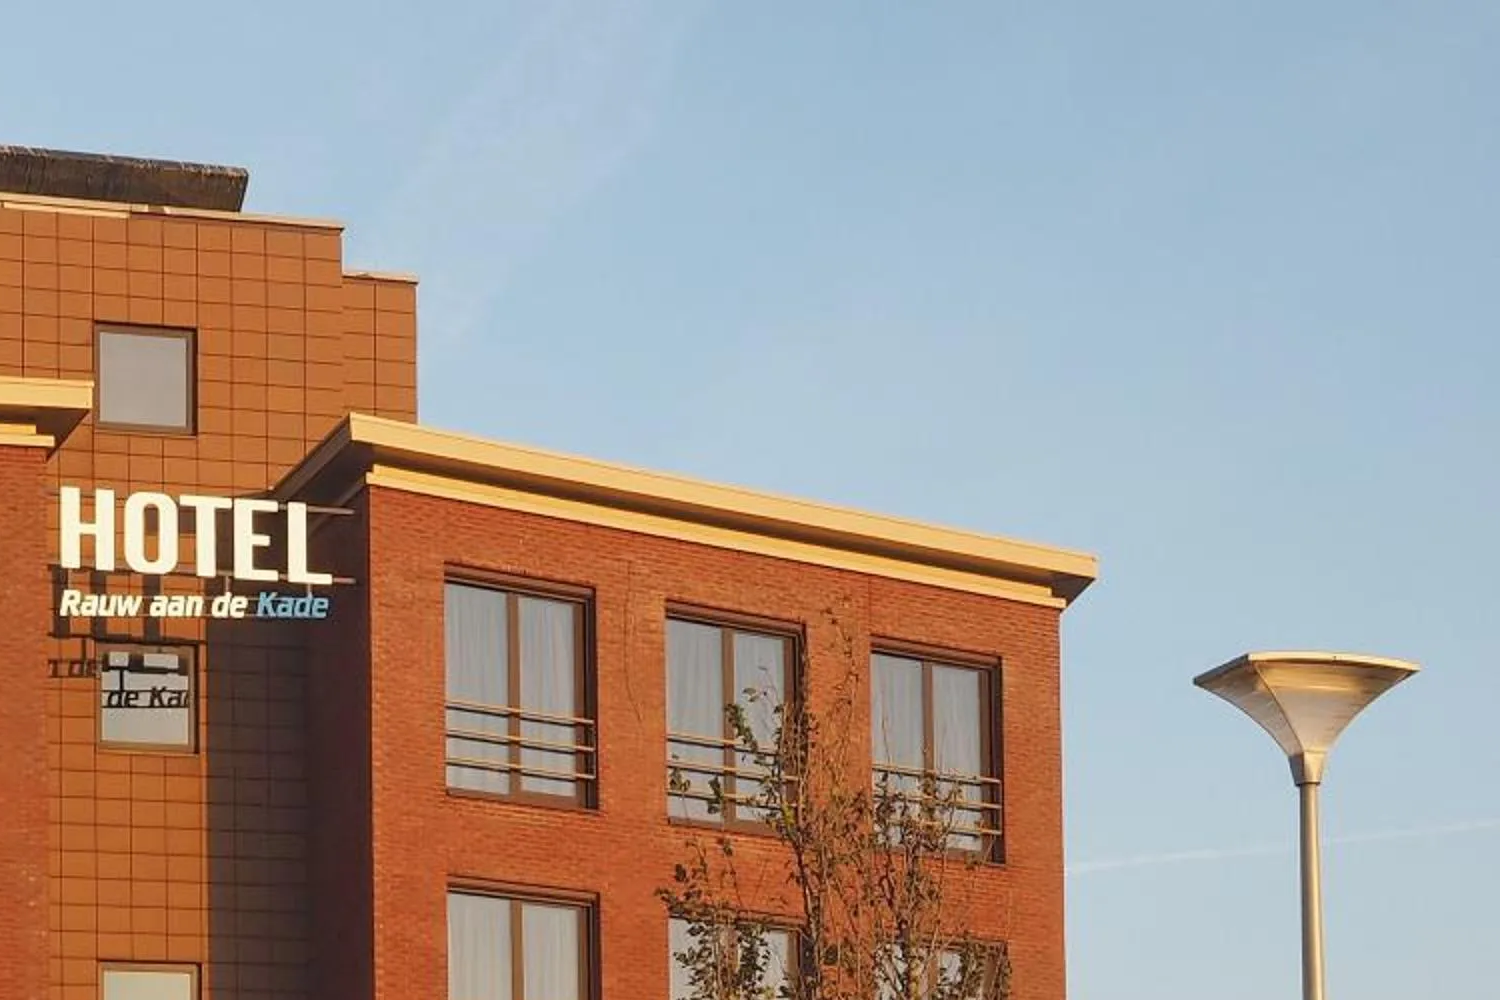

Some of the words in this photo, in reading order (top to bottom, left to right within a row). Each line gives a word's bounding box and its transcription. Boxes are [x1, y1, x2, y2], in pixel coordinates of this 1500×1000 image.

[59, 486, 333, 585] HOTEL
[59, 589, 142, 617] Rauw
[149, 593, 204, 617] aan
[211, 592, 248, 618] de
[256, 592, 330, 619] Kade
